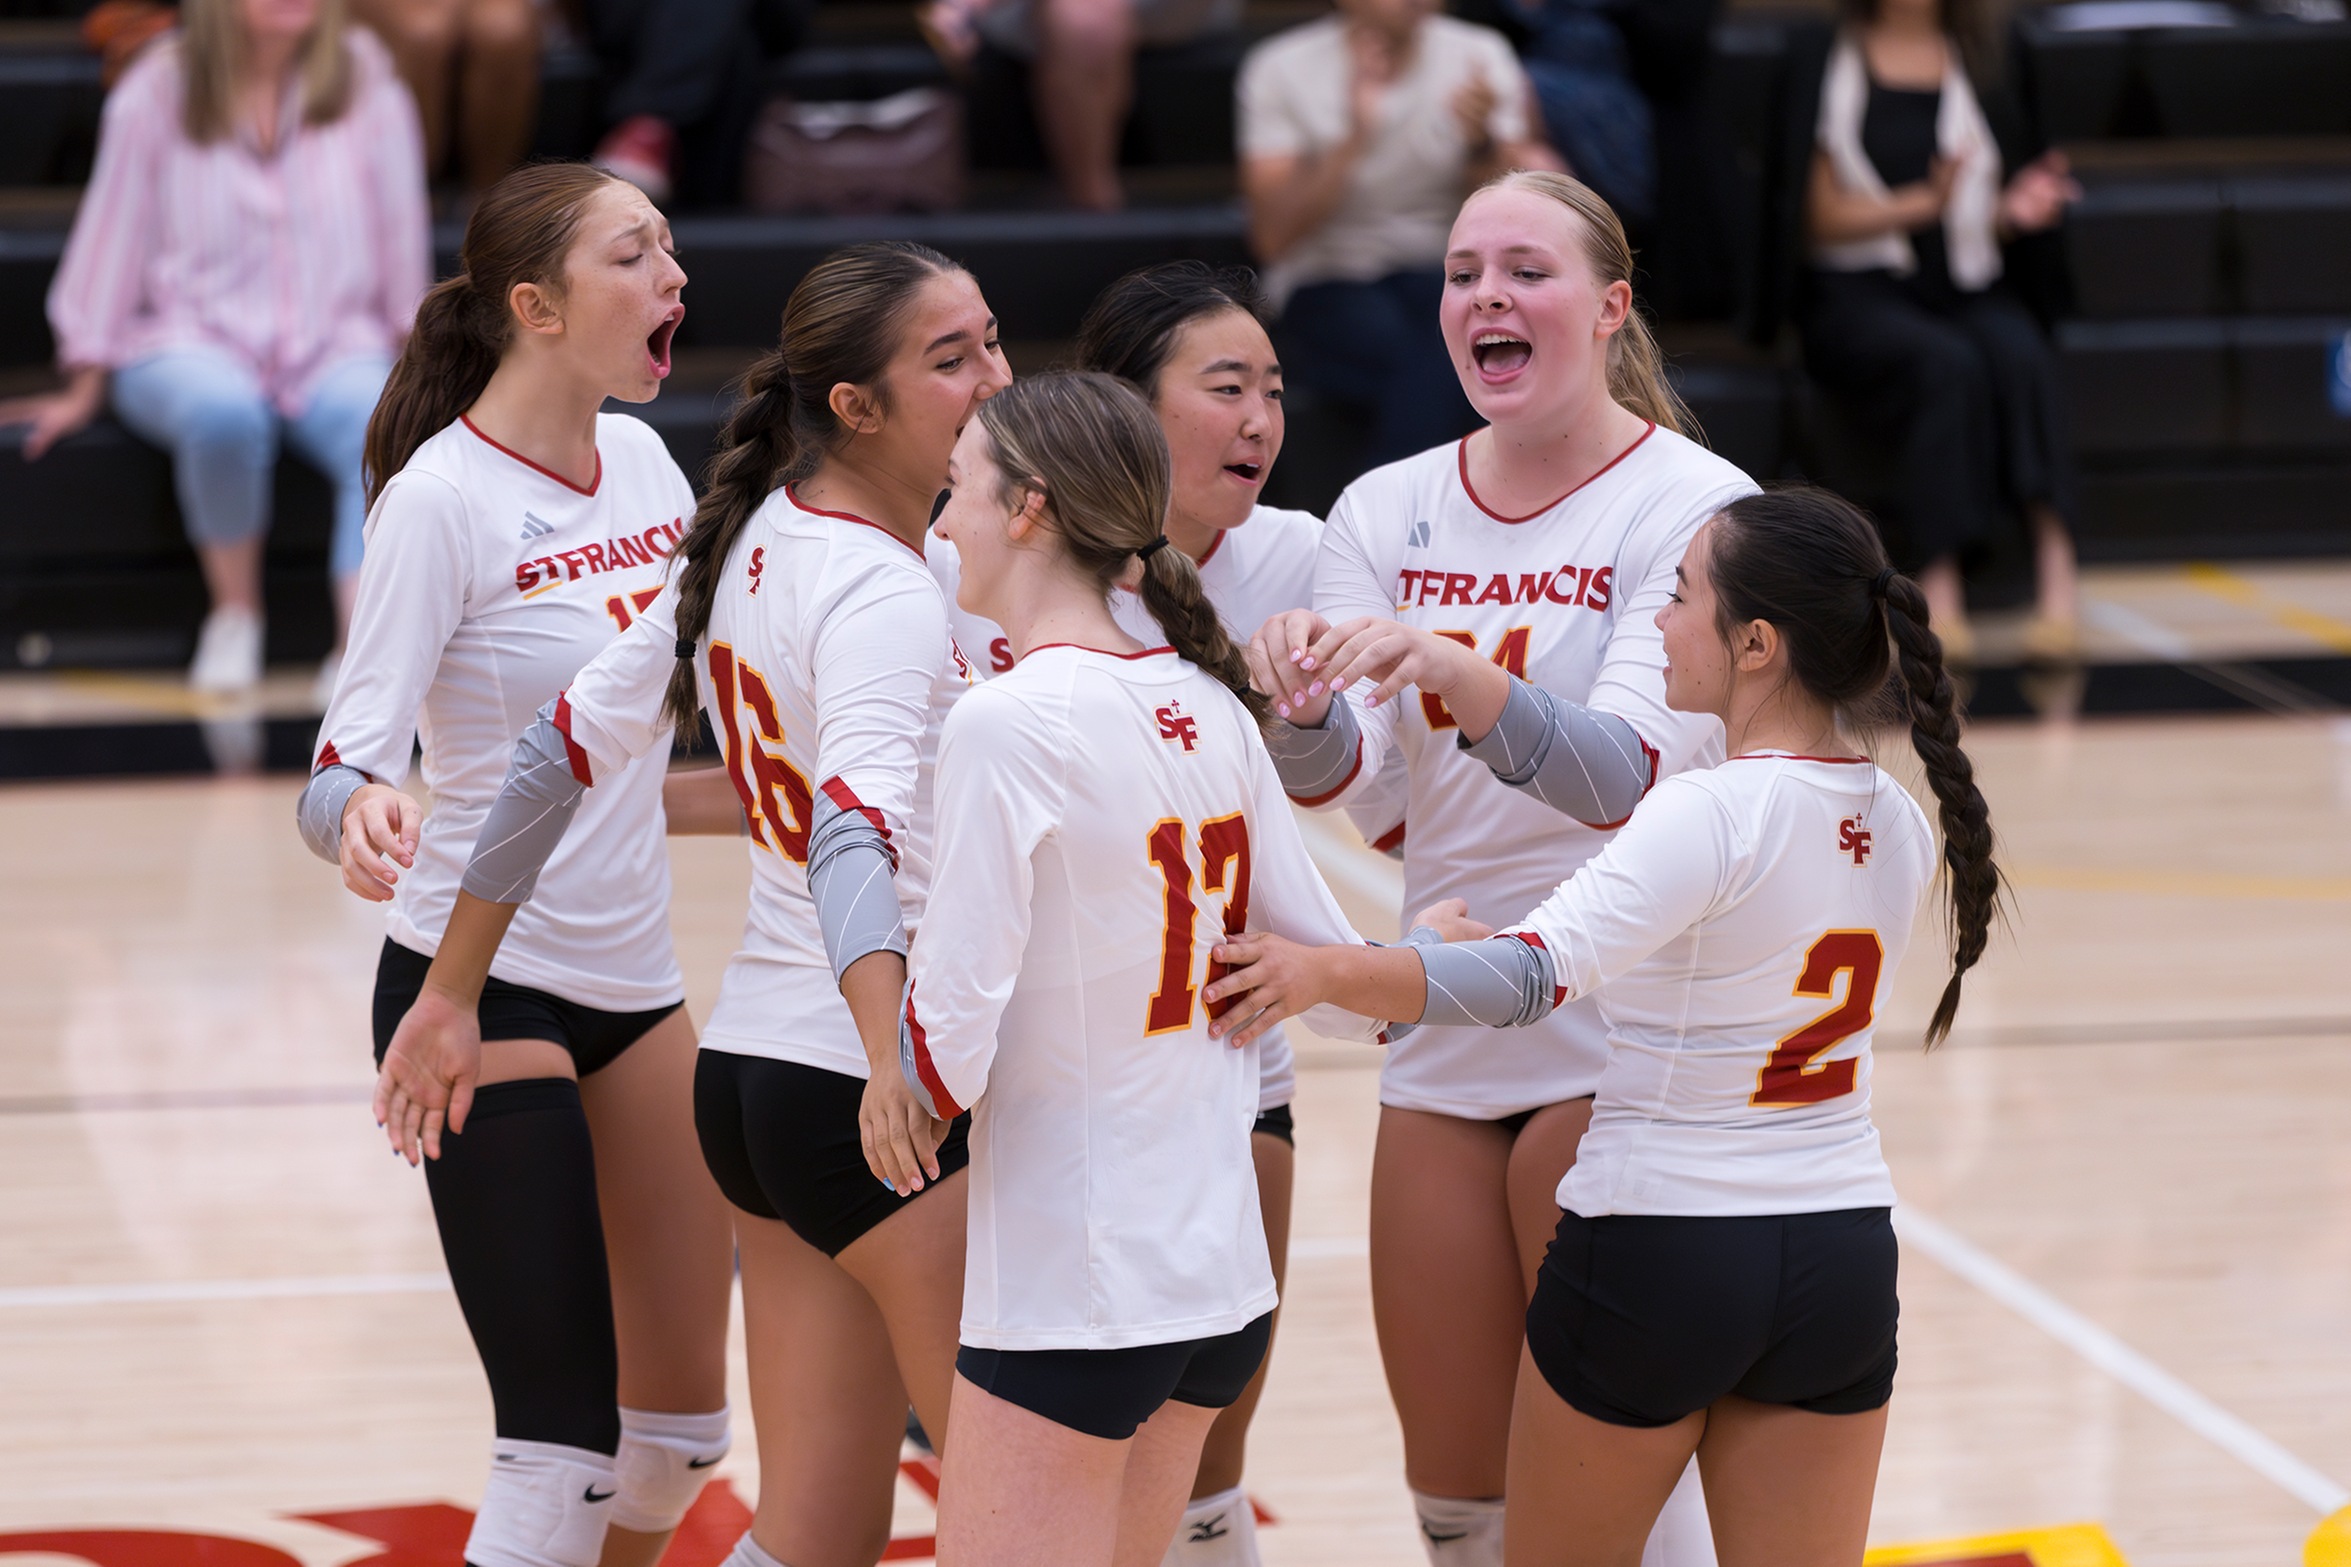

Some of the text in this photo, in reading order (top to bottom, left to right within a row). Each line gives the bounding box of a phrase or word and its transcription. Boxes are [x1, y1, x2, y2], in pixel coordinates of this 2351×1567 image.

[515, 555, 560, 593] ST
[1399, 565, 1615, 613] T FRANCIS
[990, 637, 1015, 673] S
[708, 640, 814, 867] 16
[1155, 706, 1200, 753] SF
[1838, 817, 1874, 867] SF
[1748, 929, 1884, 1107] 2
